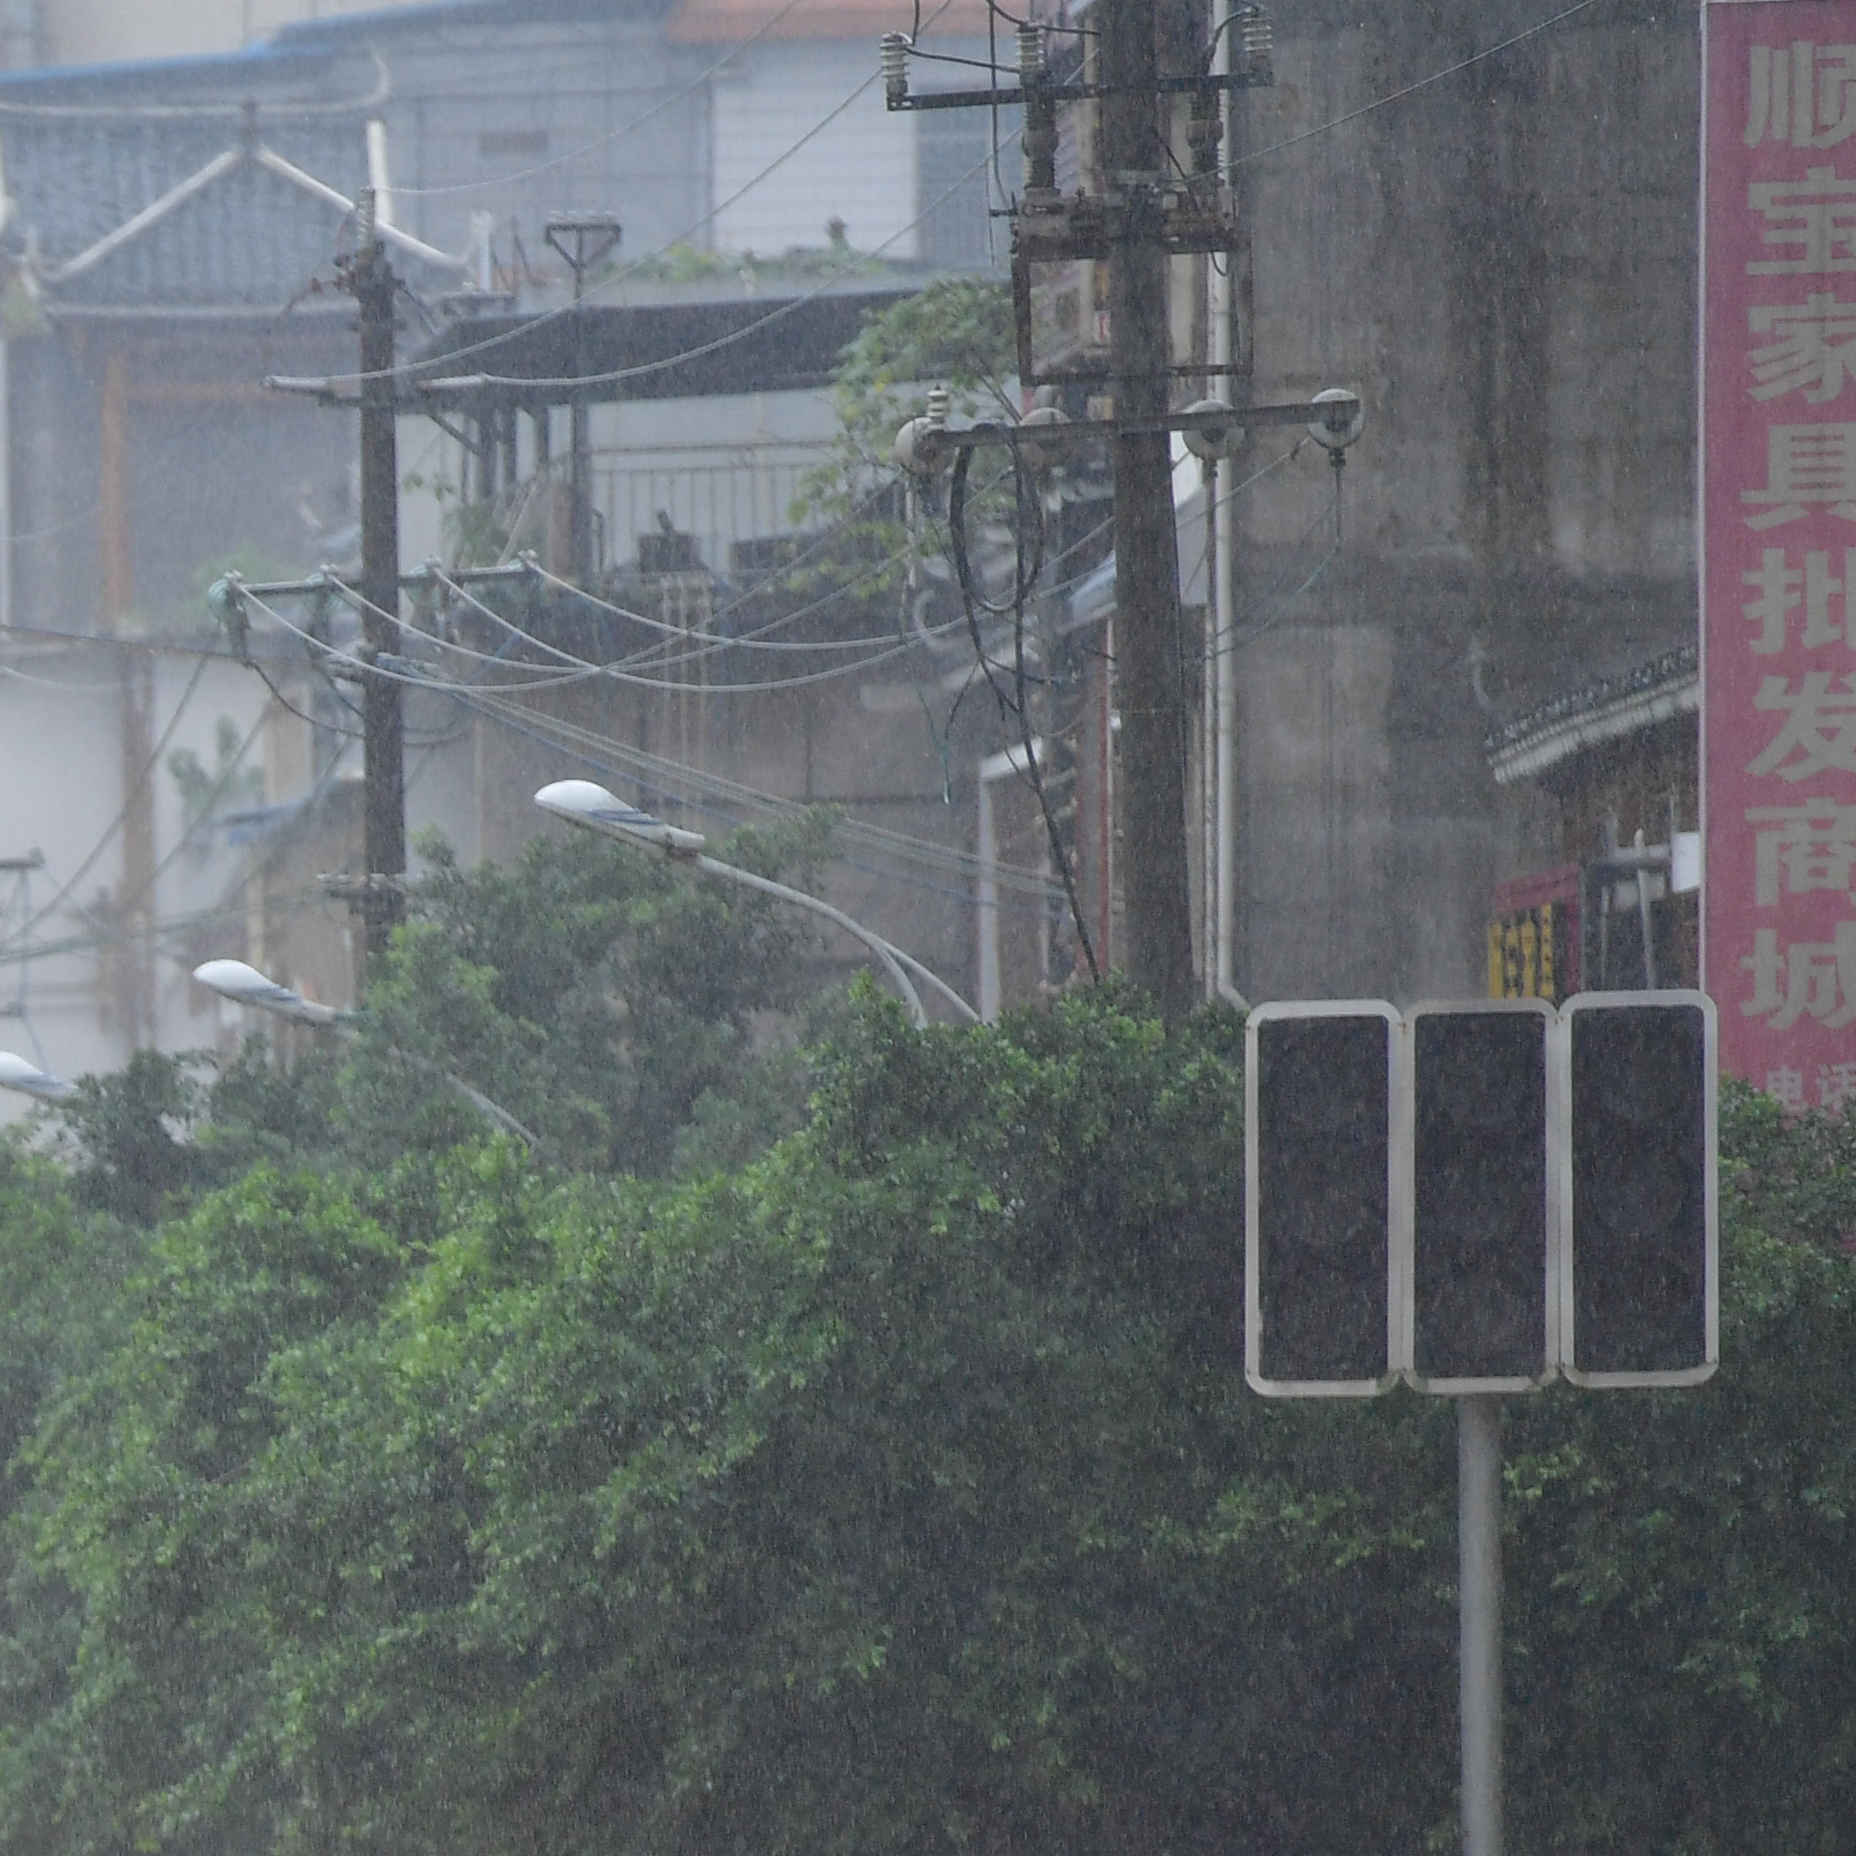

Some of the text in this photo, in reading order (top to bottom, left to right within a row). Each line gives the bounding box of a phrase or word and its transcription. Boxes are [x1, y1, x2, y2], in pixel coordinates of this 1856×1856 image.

[1740, 40, 1855, 1030] 顺宝家具批发商城
